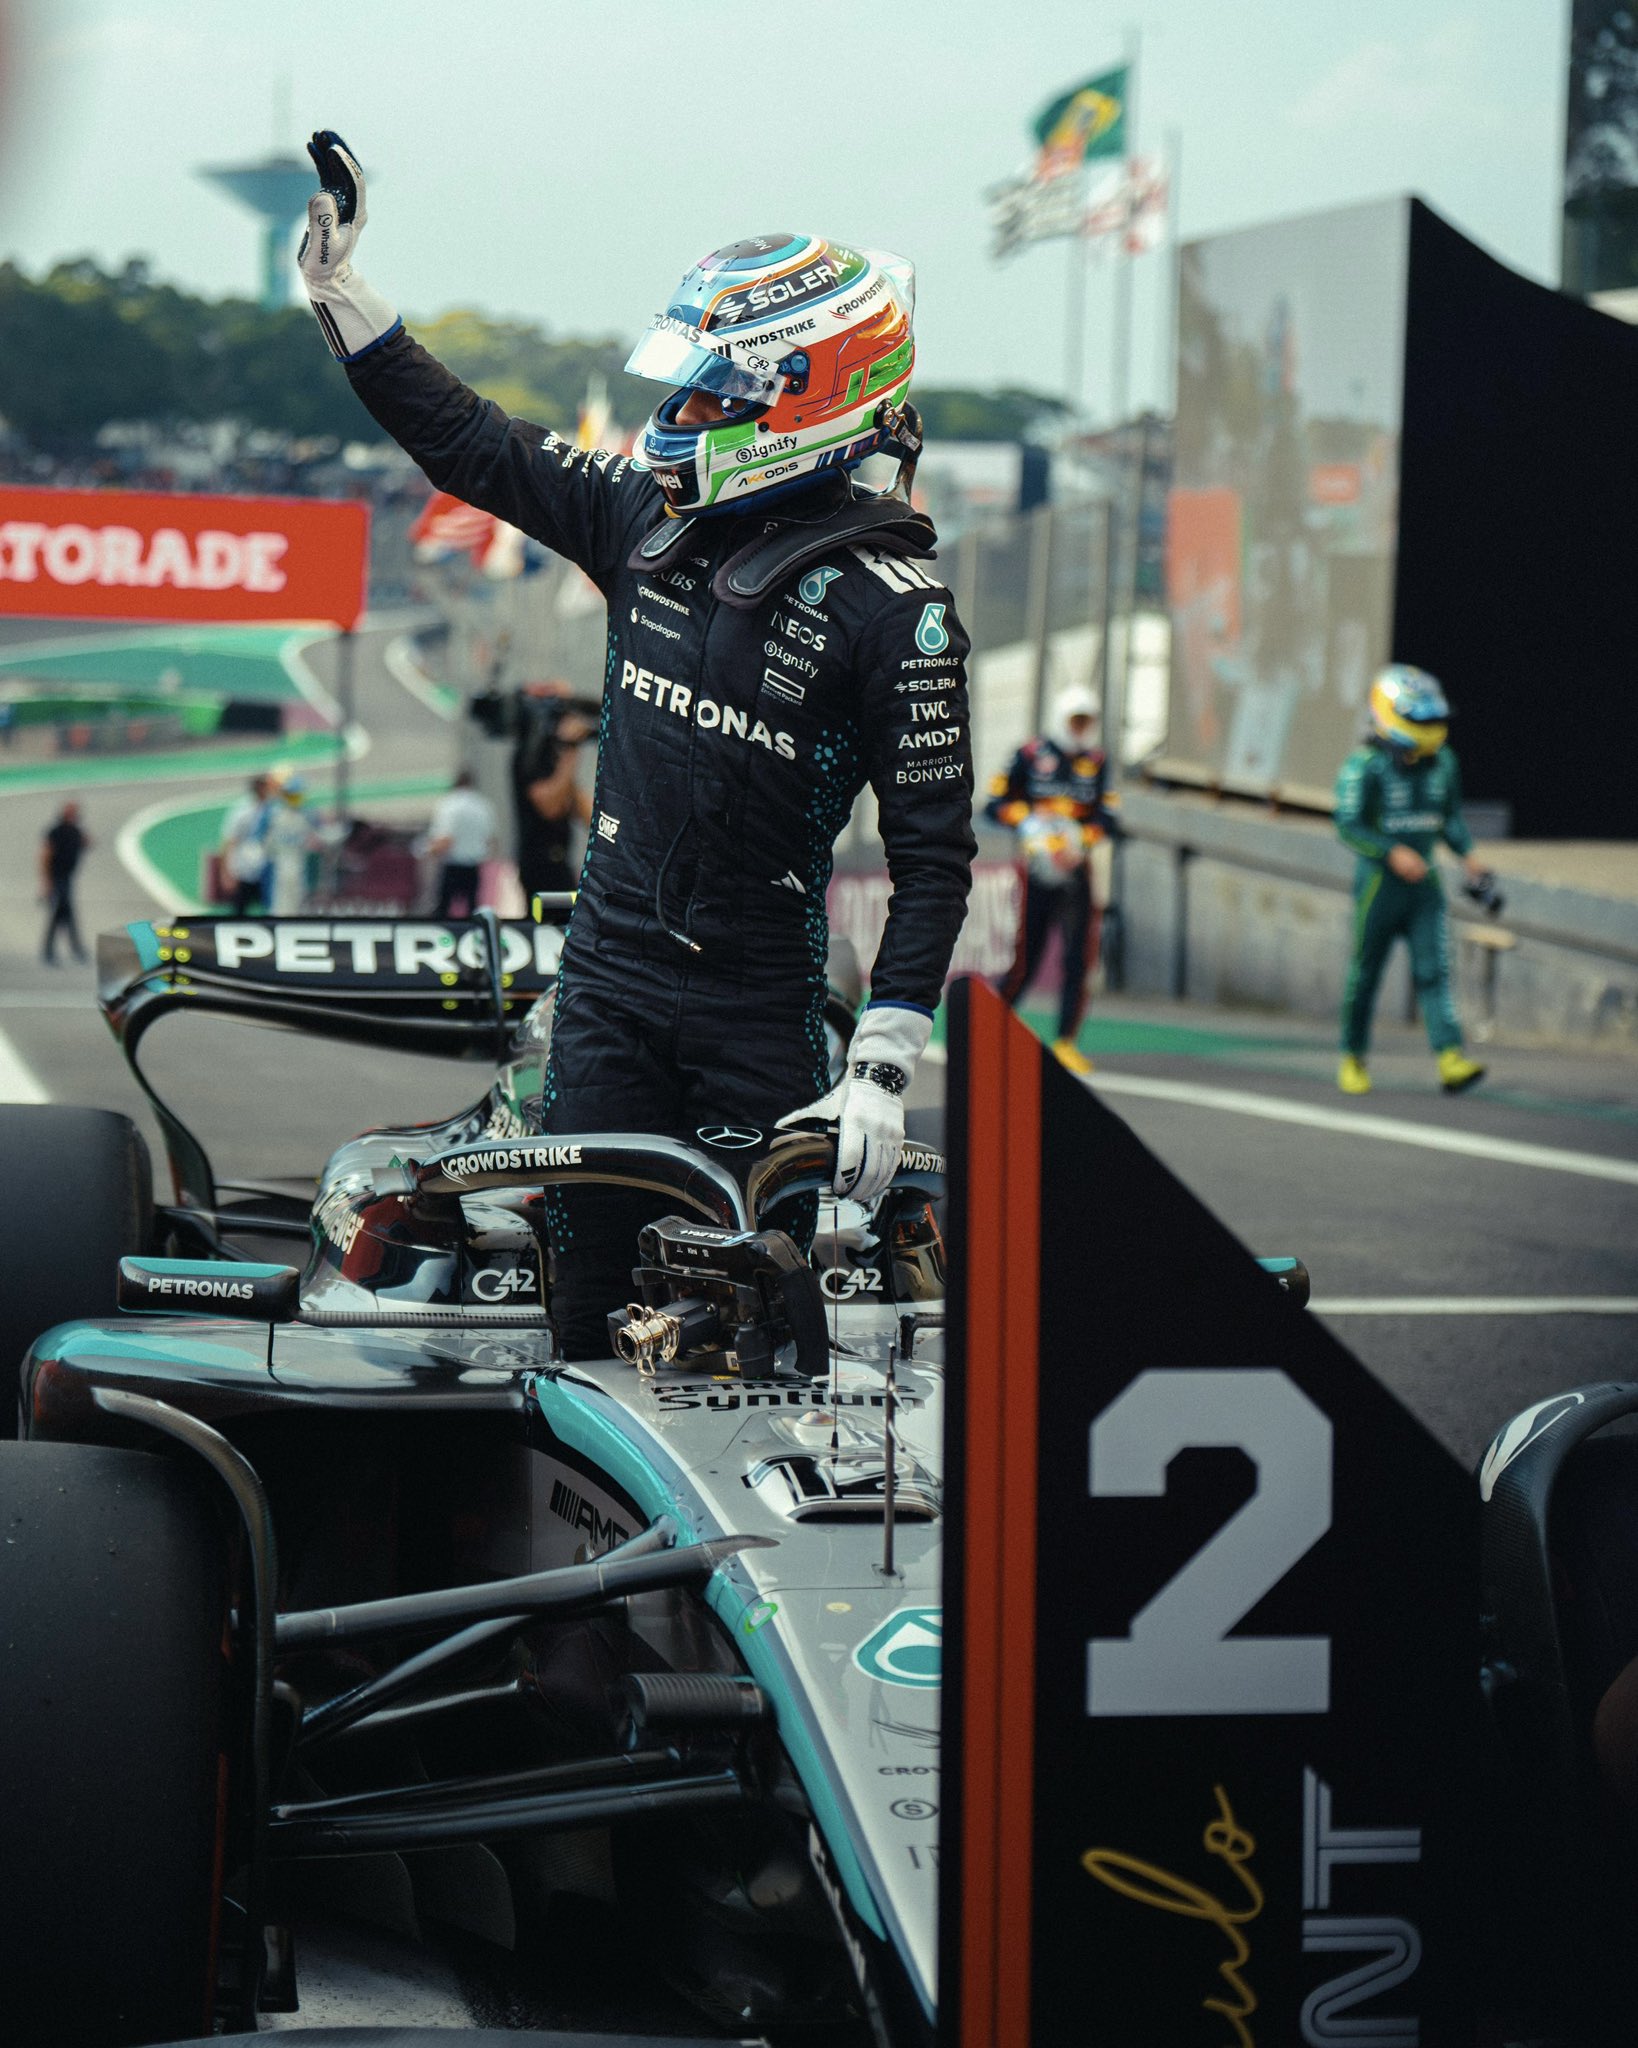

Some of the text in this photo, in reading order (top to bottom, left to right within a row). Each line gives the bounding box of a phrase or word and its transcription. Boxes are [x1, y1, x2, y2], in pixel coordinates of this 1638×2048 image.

[320, 227, 331, 266] WhatsApp
[749, 260, 851, 312] SOLERA
[735, 318, 816, 349] OWDSTRIKE
[736, 436, 797, 463] Signify
[0, 521, 289, 593] TORADE
[639, 585, 690, 616] CROWDSTRIKE
[783, 593, 829, 623] PETRONAS
[640, 614, 681, 640] Snapdragon
[764, 640, 819, 679] Signify
[901, 656, 959, 670] PETRONAS
[908, 677, 957, 692] SOLERA
[620, 658, 798, 761] PETRONAS
[910, 700, 950, 722] IWC
[898, 730, 946, 749] AMD
[896, 763, 964, 784] BONVOY
[907, 755, 953, 768] MARRIOTT
[446, 1145, 582, 1177] CROWDSTRIKE
[148, 1277, 254, 1300] PETRONAS
[472, 1268, 537, 1302] G42
[820, 1267, 884, 1300] G42
[659, 1390, 927, 1412] Syntium
[1086, 1368, 1333, 1717] 2
[1300, 1764, 1422, 2048] NT
